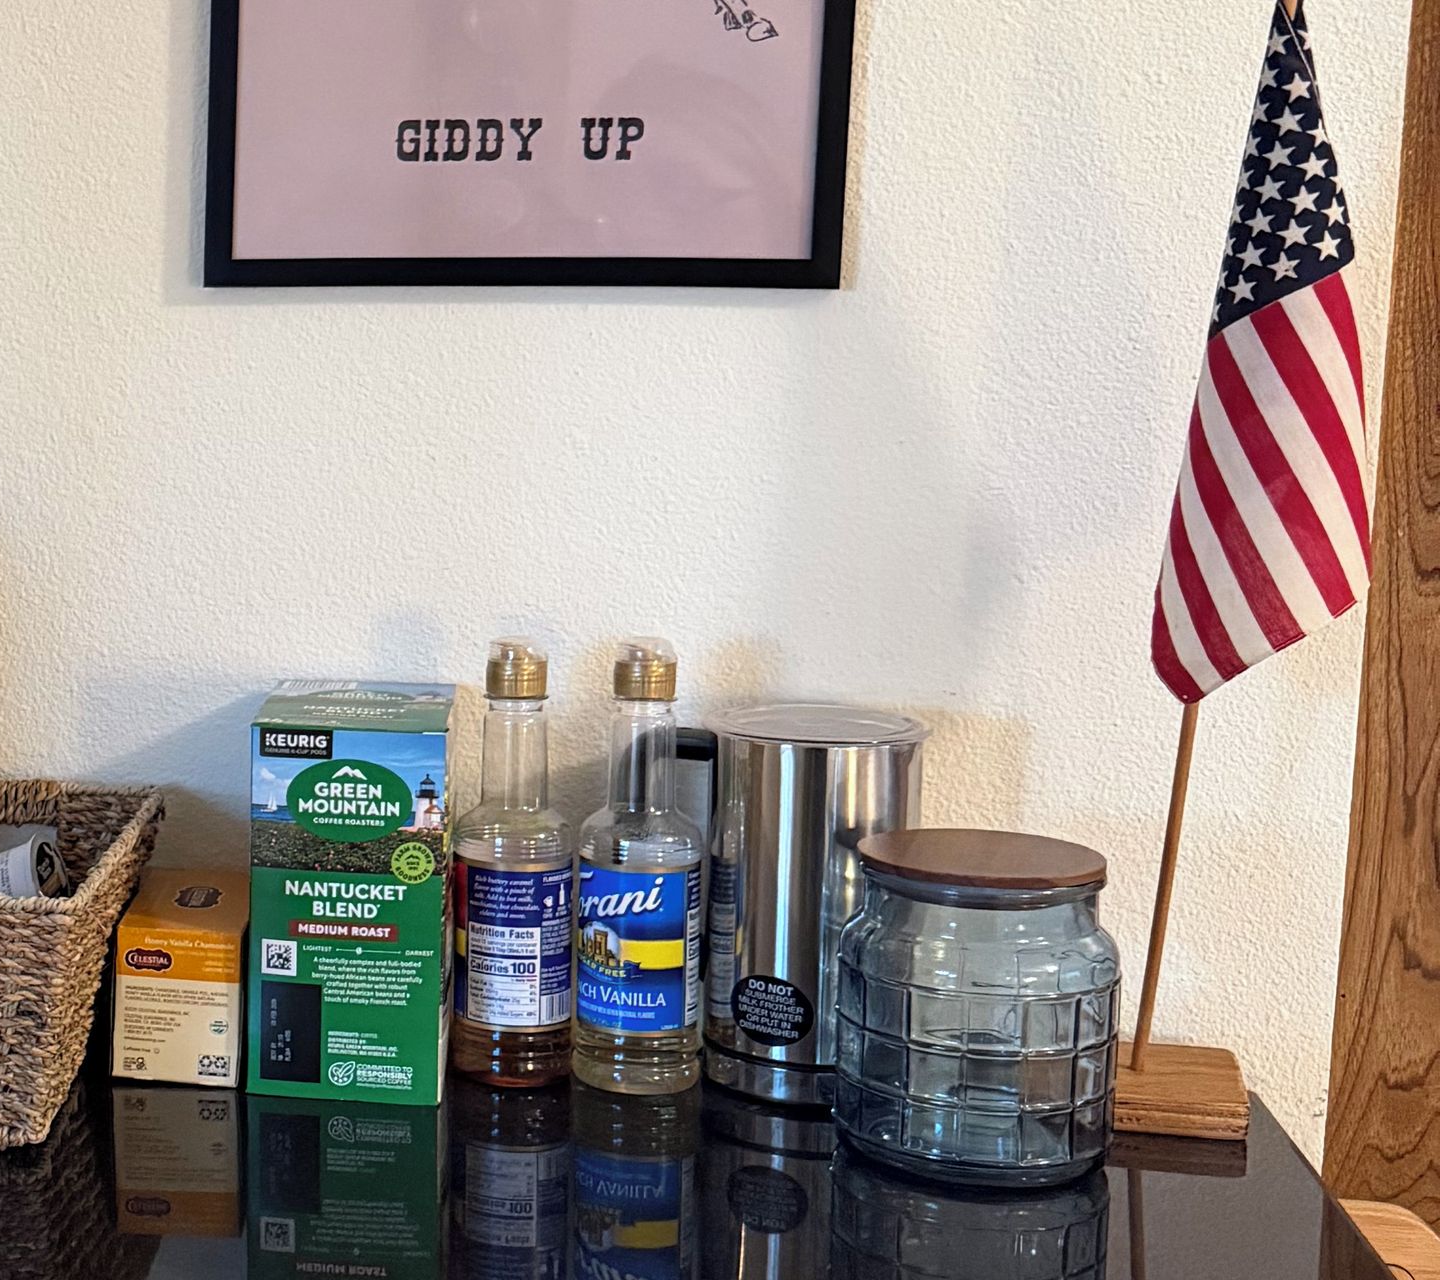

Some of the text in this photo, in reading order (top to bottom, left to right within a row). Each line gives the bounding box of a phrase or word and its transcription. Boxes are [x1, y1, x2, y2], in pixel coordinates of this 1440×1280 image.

[395, 117, 645, 162] GIDDY UP
[265, 732, 328, 748] KEURIG
[314, 781, 382, 799] GREEN
[298, 798, 400, 817] MOUNTAIN
[313, 817, 384, 826] COFFEE ROASTERS
[285, 879, 407, 901] NANTUCKET
[312, 901, 379, 918] BLEND
[298, 923, 391, 938] MEDIUM ROAST
[470, 923, 534, 939] Nutrition Facts
[128, 952, 169, 965] CELESTIAL
[470, 959, 509, 974] Calories
[511, 962, 536, 974] 100
[599, 966, 626, 978] FREE
[600, 985, 667, 1007] VANILLA
[748, 979, 794, 996] DO NOT
[738, 994, 804, 1014] MILK FROTHER
[744, 988, 796, 1006] SUBMERGE
[738, 1003, 803, 1023] UNDER WATER
[745, 1013, 791, 1030] OR PUT IN
[739, 1019, 799, 1039] DISHWASHER
[356, 1064, 401, 1073] COMMITTED
[356, 1070, 413, 1079] RESPONSIBLY
